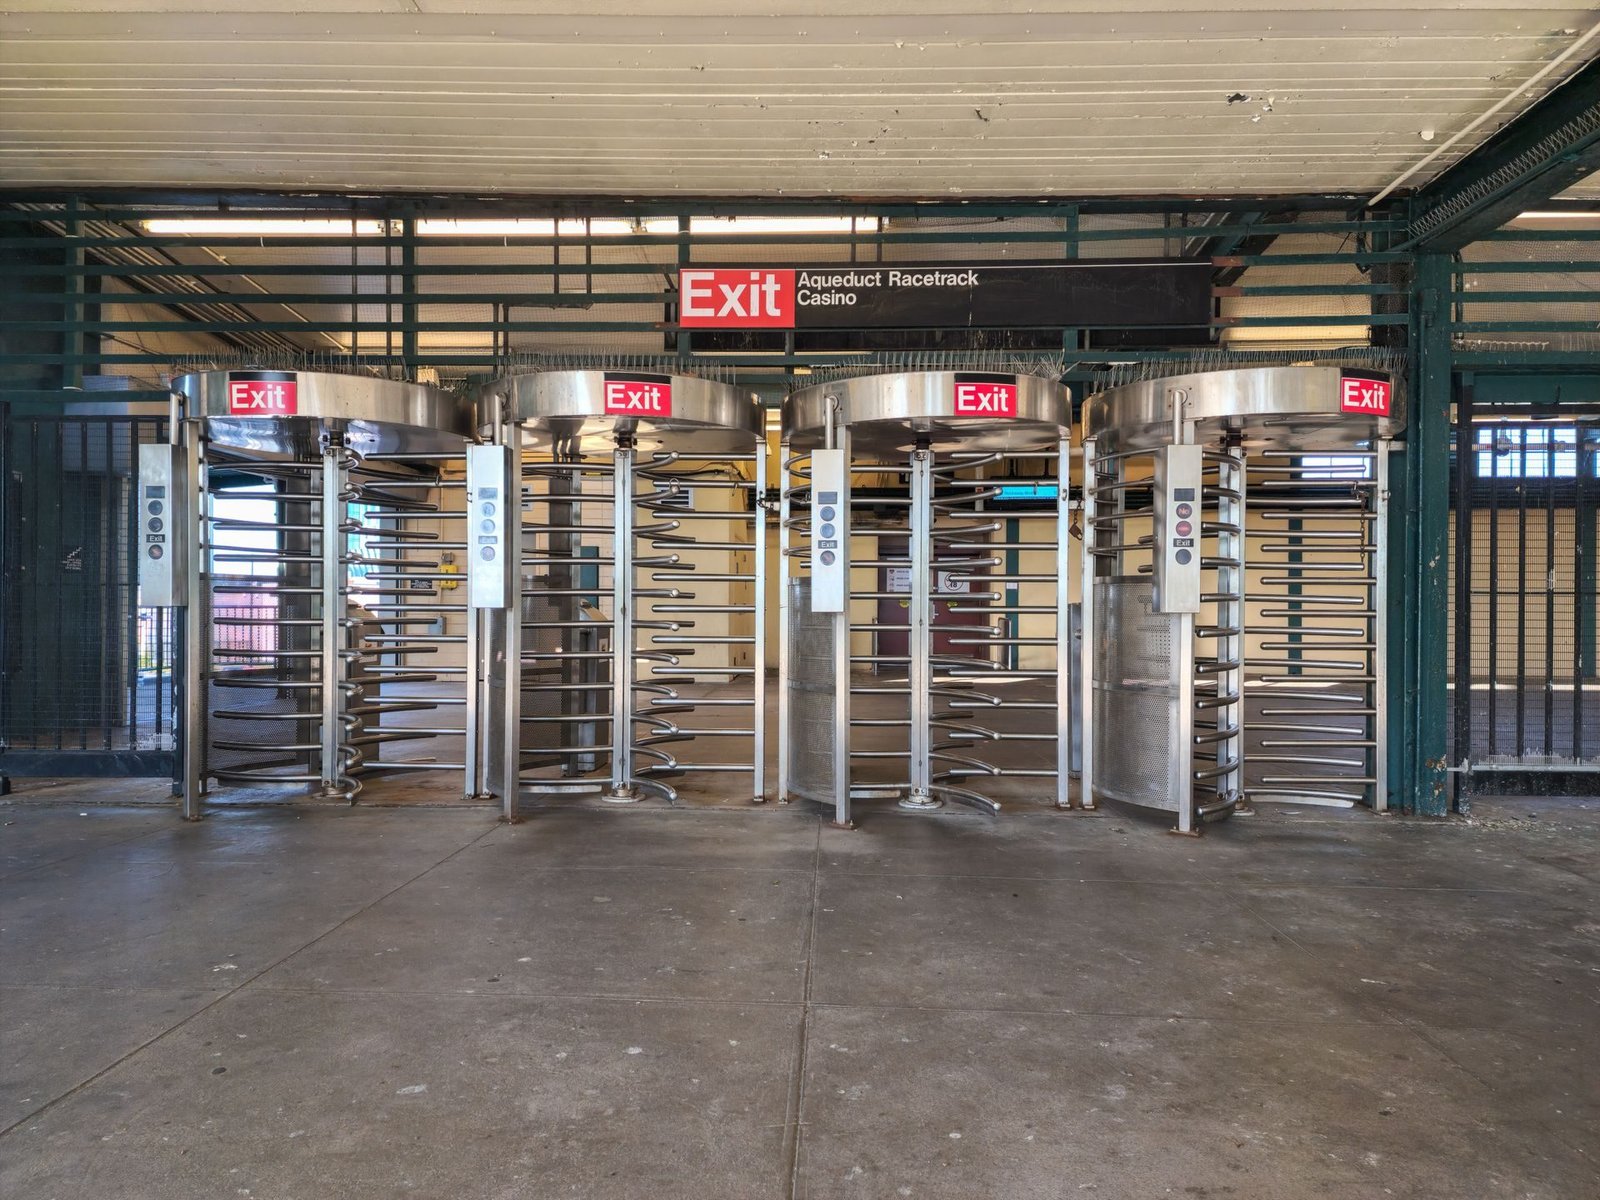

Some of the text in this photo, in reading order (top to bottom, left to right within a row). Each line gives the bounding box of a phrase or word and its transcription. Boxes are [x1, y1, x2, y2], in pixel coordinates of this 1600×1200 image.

[797, 270, 979, 290] Aqueduct Racetrack
[681, 271, 781, 317] Exit
[797, 289, 857, 306] Casino
[231, 384, 286, 409] Exit
[607, 384, 662, 411] Exit
[958, 386, 1009, 412] Exit
[1344, 381, 1385, 410] Exit
[1176, 539, 1191, 547] Exit
